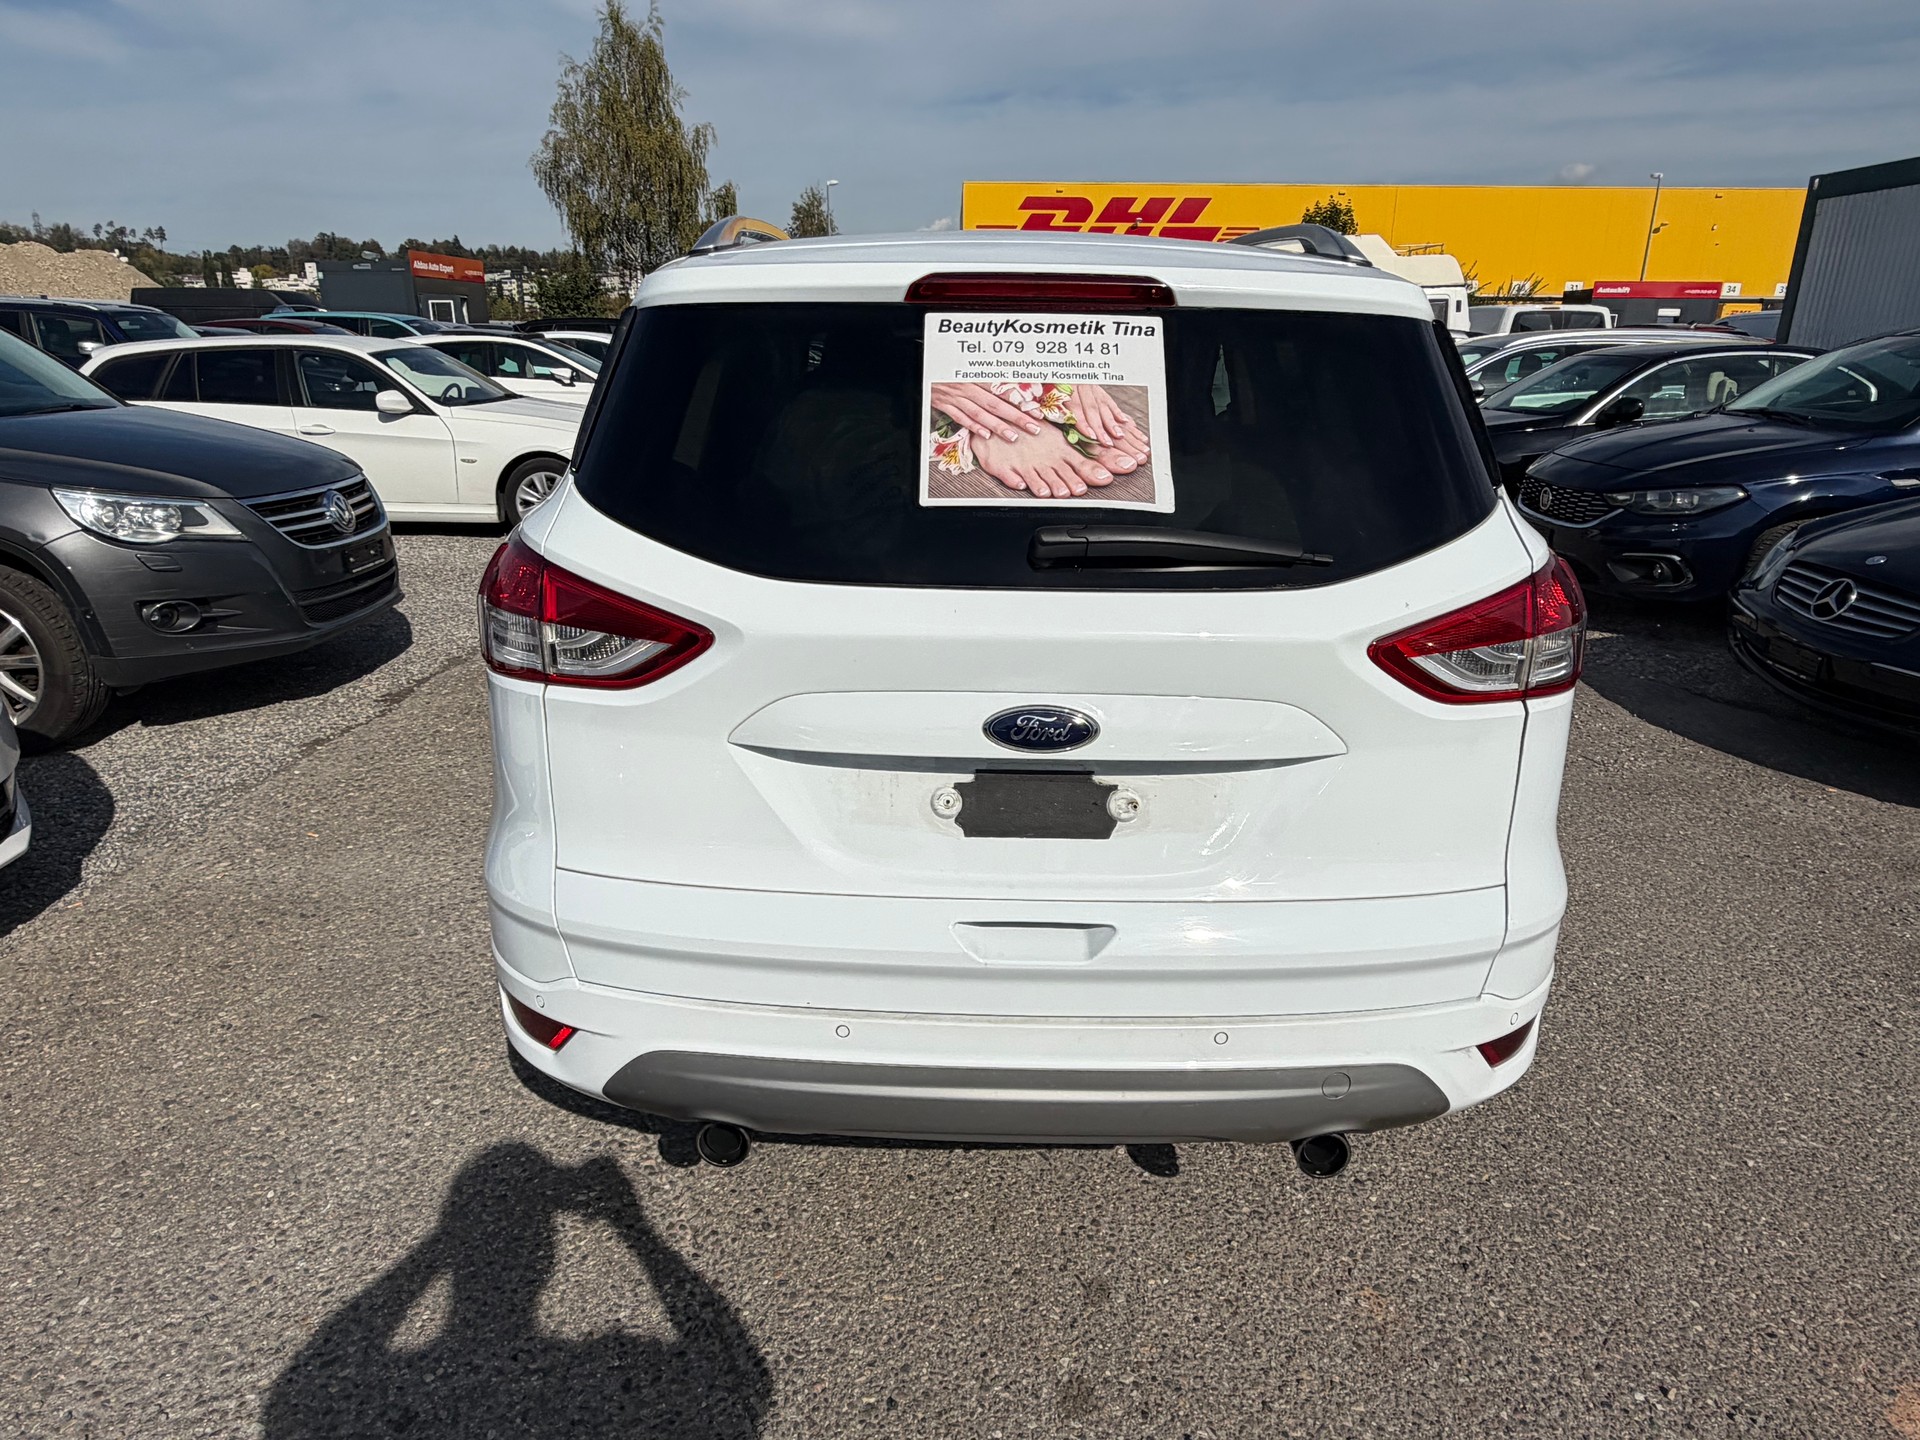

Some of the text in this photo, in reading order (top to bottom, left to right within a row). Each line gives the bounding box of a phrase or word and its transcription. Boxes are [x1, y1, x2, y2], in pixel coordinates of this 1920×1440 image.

[1018, 196, 1222, 242] DHL
[428, 262, 439, 271] Auto
[439, 263, 454, 273] Export
[1726, 285, 1737, 294] 34
[938, 318, 1156, 337] BeautyKosmetik Tina
[957, 340, 1119, 355] Tel. 079 928 14 81
[968, 359, 1110, 370] www.beautykosmetiktina.ch
[955, 370, 1124, 381] Facebook: Beauty Kosmetik Tina
[1010, 714, 1073, 742] Ford
